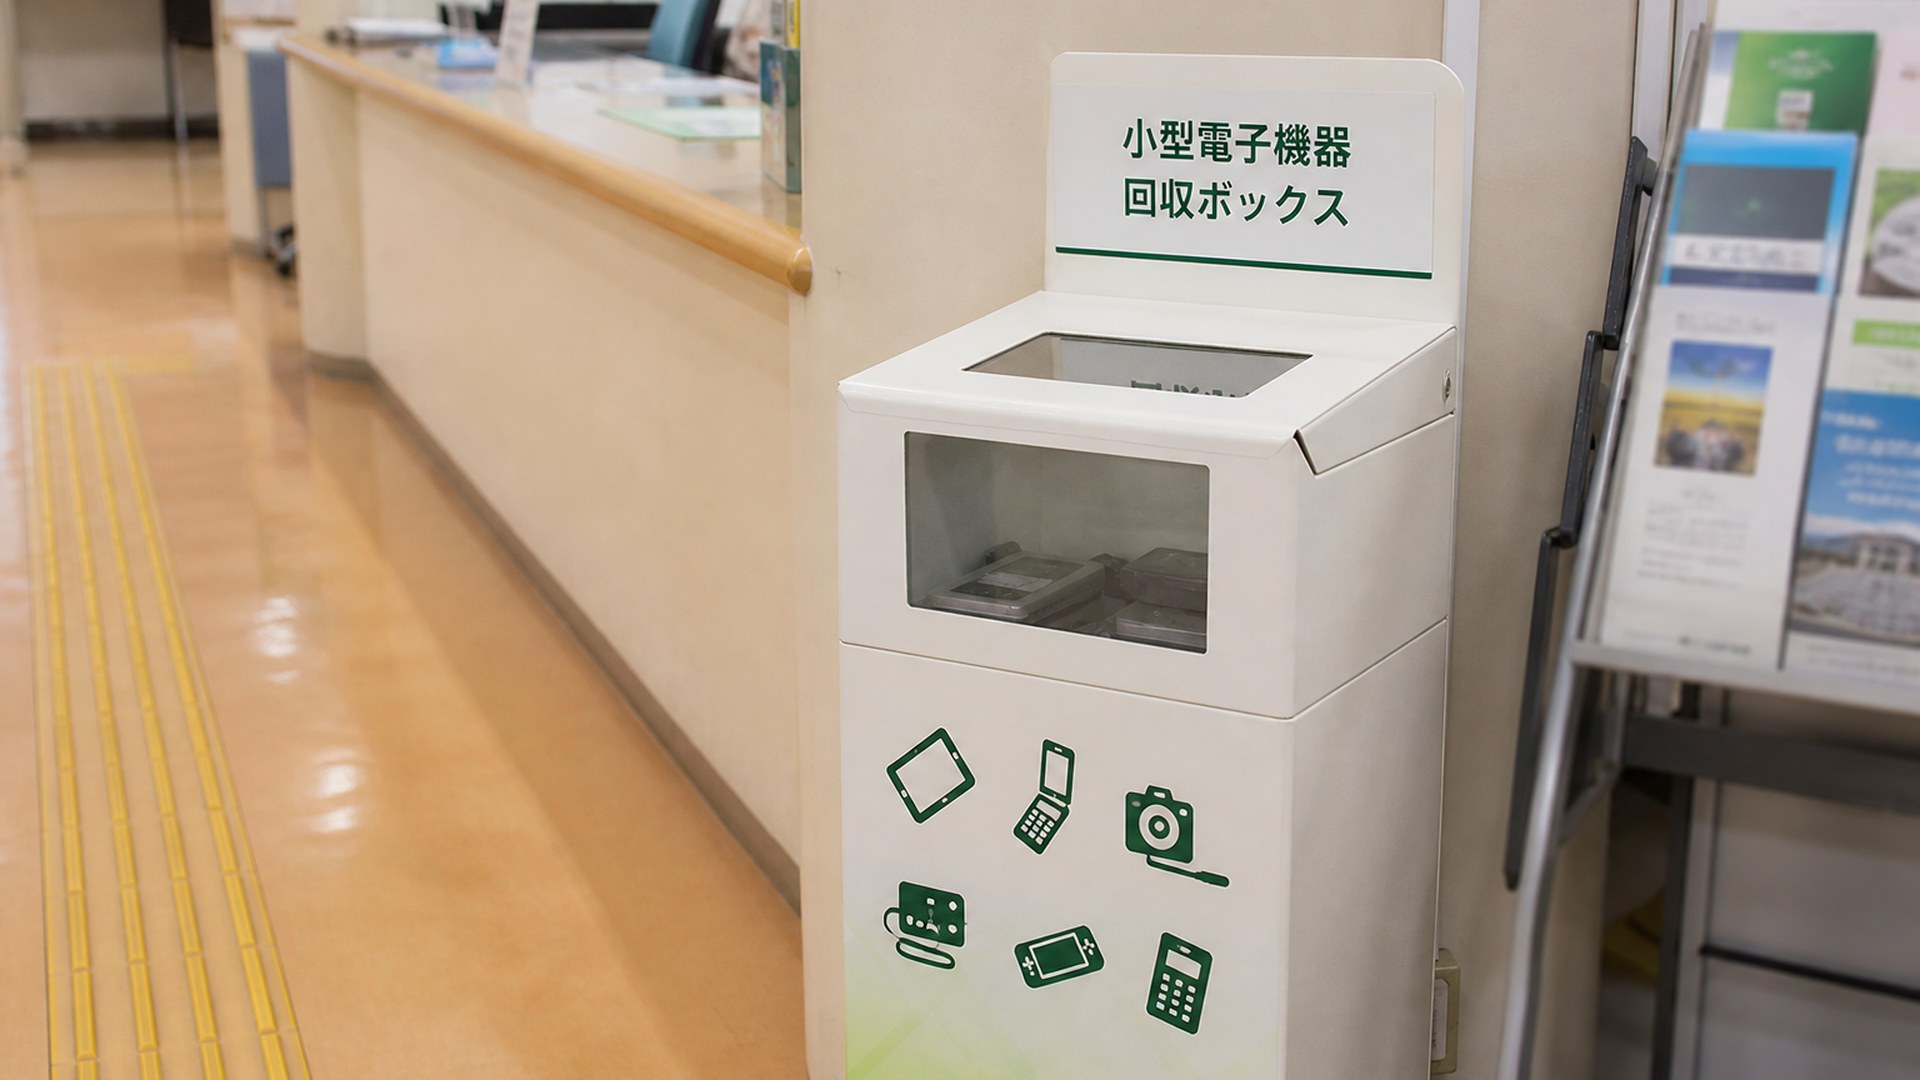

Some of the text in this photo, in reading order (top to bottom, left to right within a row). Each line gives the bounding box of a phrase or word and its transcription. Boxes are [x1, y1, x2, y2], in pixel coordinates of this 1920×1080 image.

[1123, 118, 1351, 168] 小型電子機器
[1124, 177, 1349, 226] 回収ボックス
